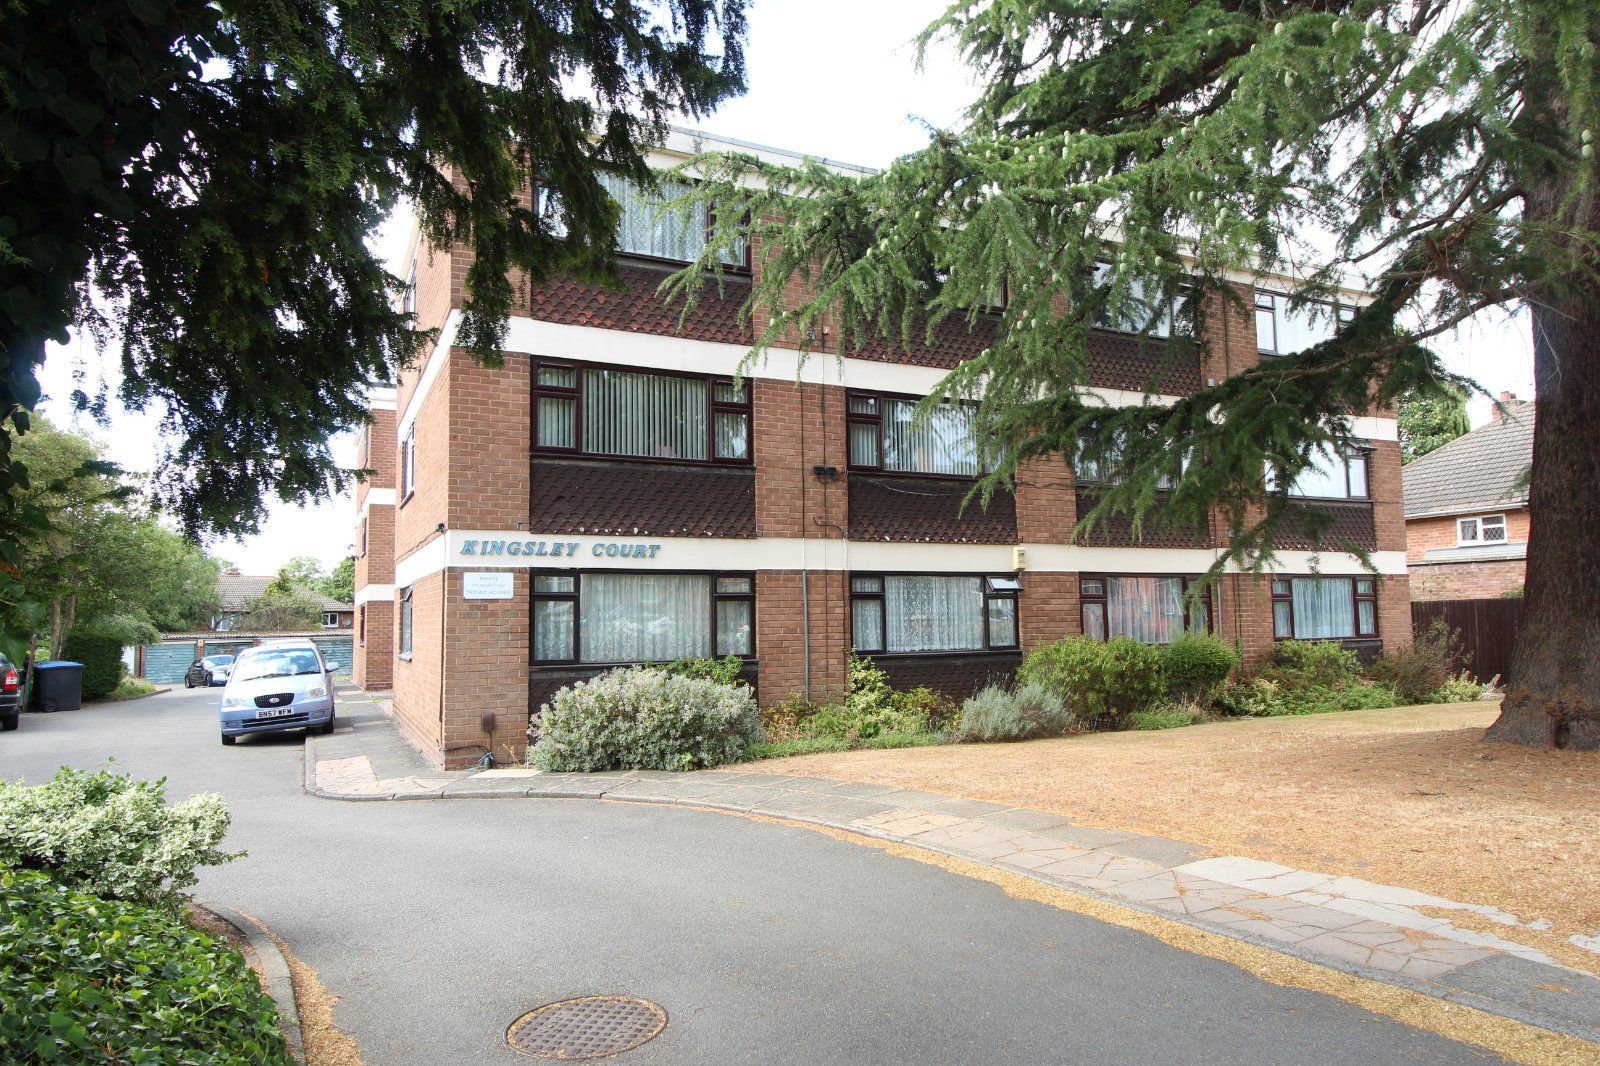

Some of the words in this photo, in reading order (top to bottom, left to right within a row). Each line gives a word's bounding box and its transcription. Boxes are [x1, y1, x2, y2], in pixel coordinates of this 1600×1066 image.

[460, 540, 580, 557] KINGSLEY
[591, 543, 661, 558] COURT
[258, 710, 277, 718] BN57
